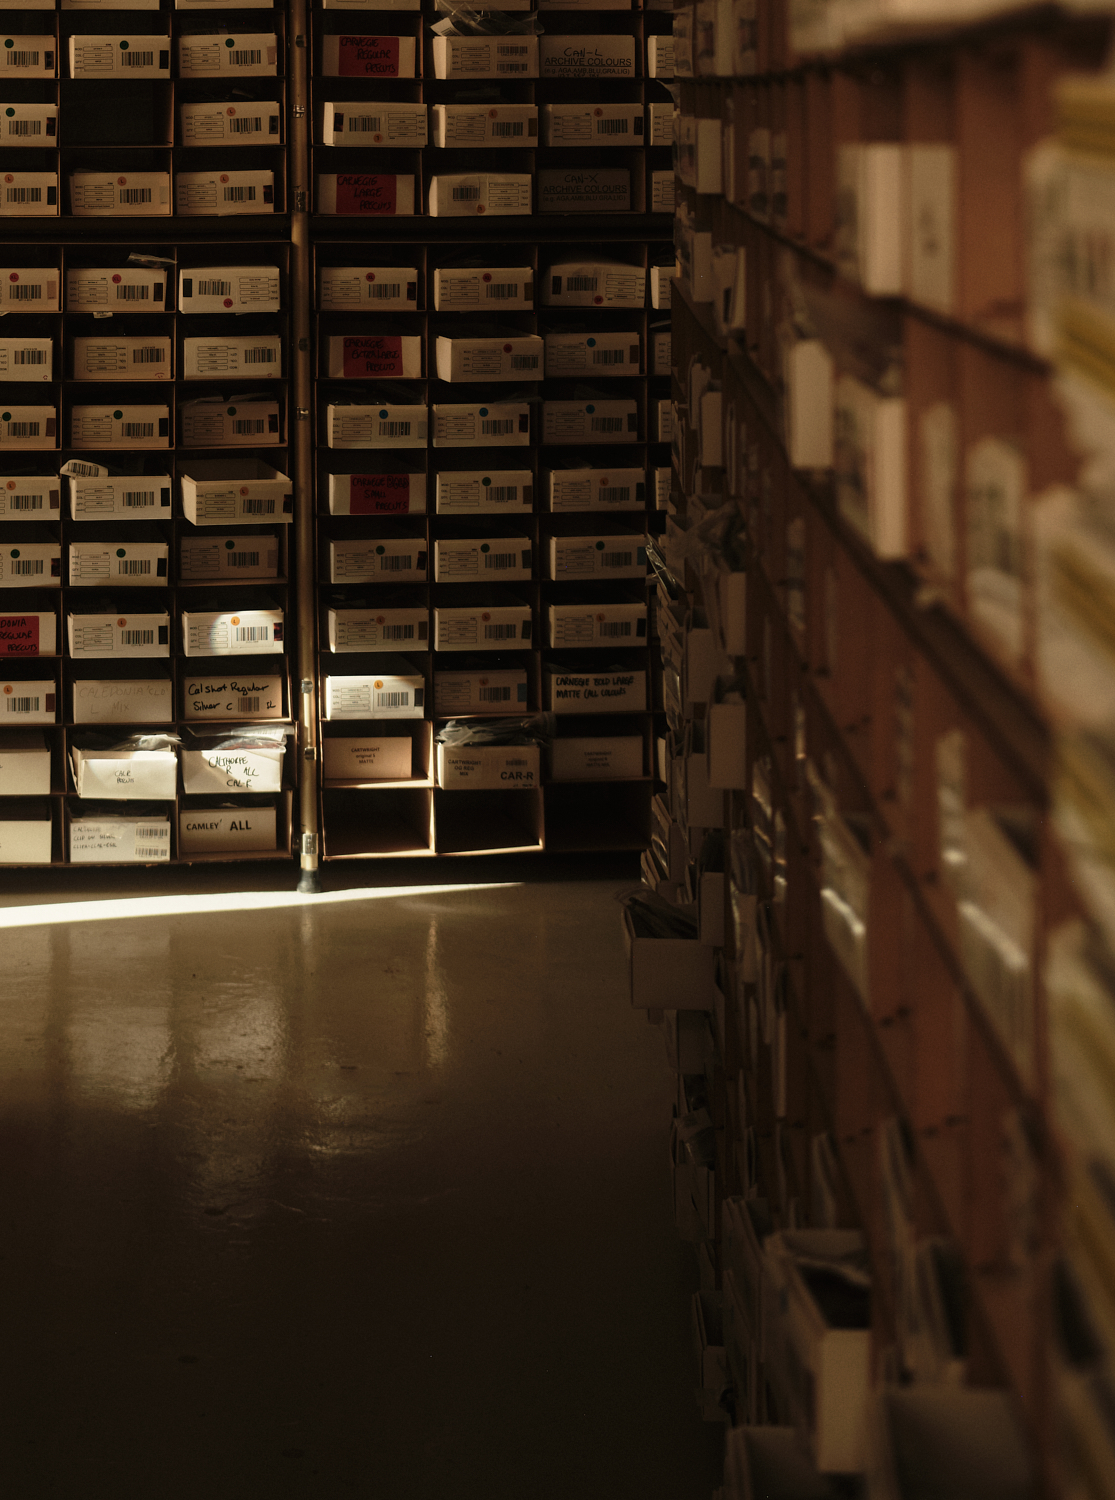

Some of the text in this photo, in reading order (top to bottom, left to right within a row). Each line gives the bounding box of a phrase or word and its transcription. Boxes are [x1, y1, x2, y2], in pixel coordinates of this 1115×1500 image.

[357, 48, 391, 60] REGULAR
[564, 47, 603, 57] CAN-L
[544, 57, 632, 67] ARCHIVE COLOURS
[564, 173, 598, 184] CAN-X
[353, 187, 384, 198] LARGE
[543, 184, 628, 194] ARCHIVE COLOURS
[7, 643, 37, 652] PRECUTS
[555, 676, 590, 688] CARNEGIE
[230, 681, 270, 696] Regular
[556, 689, 581, 699] MATTE
[601, 687, 626, 697] COLOURS
[500, 771, 534, 781] CAR-R
[230, 819, 252, 831] ALL
